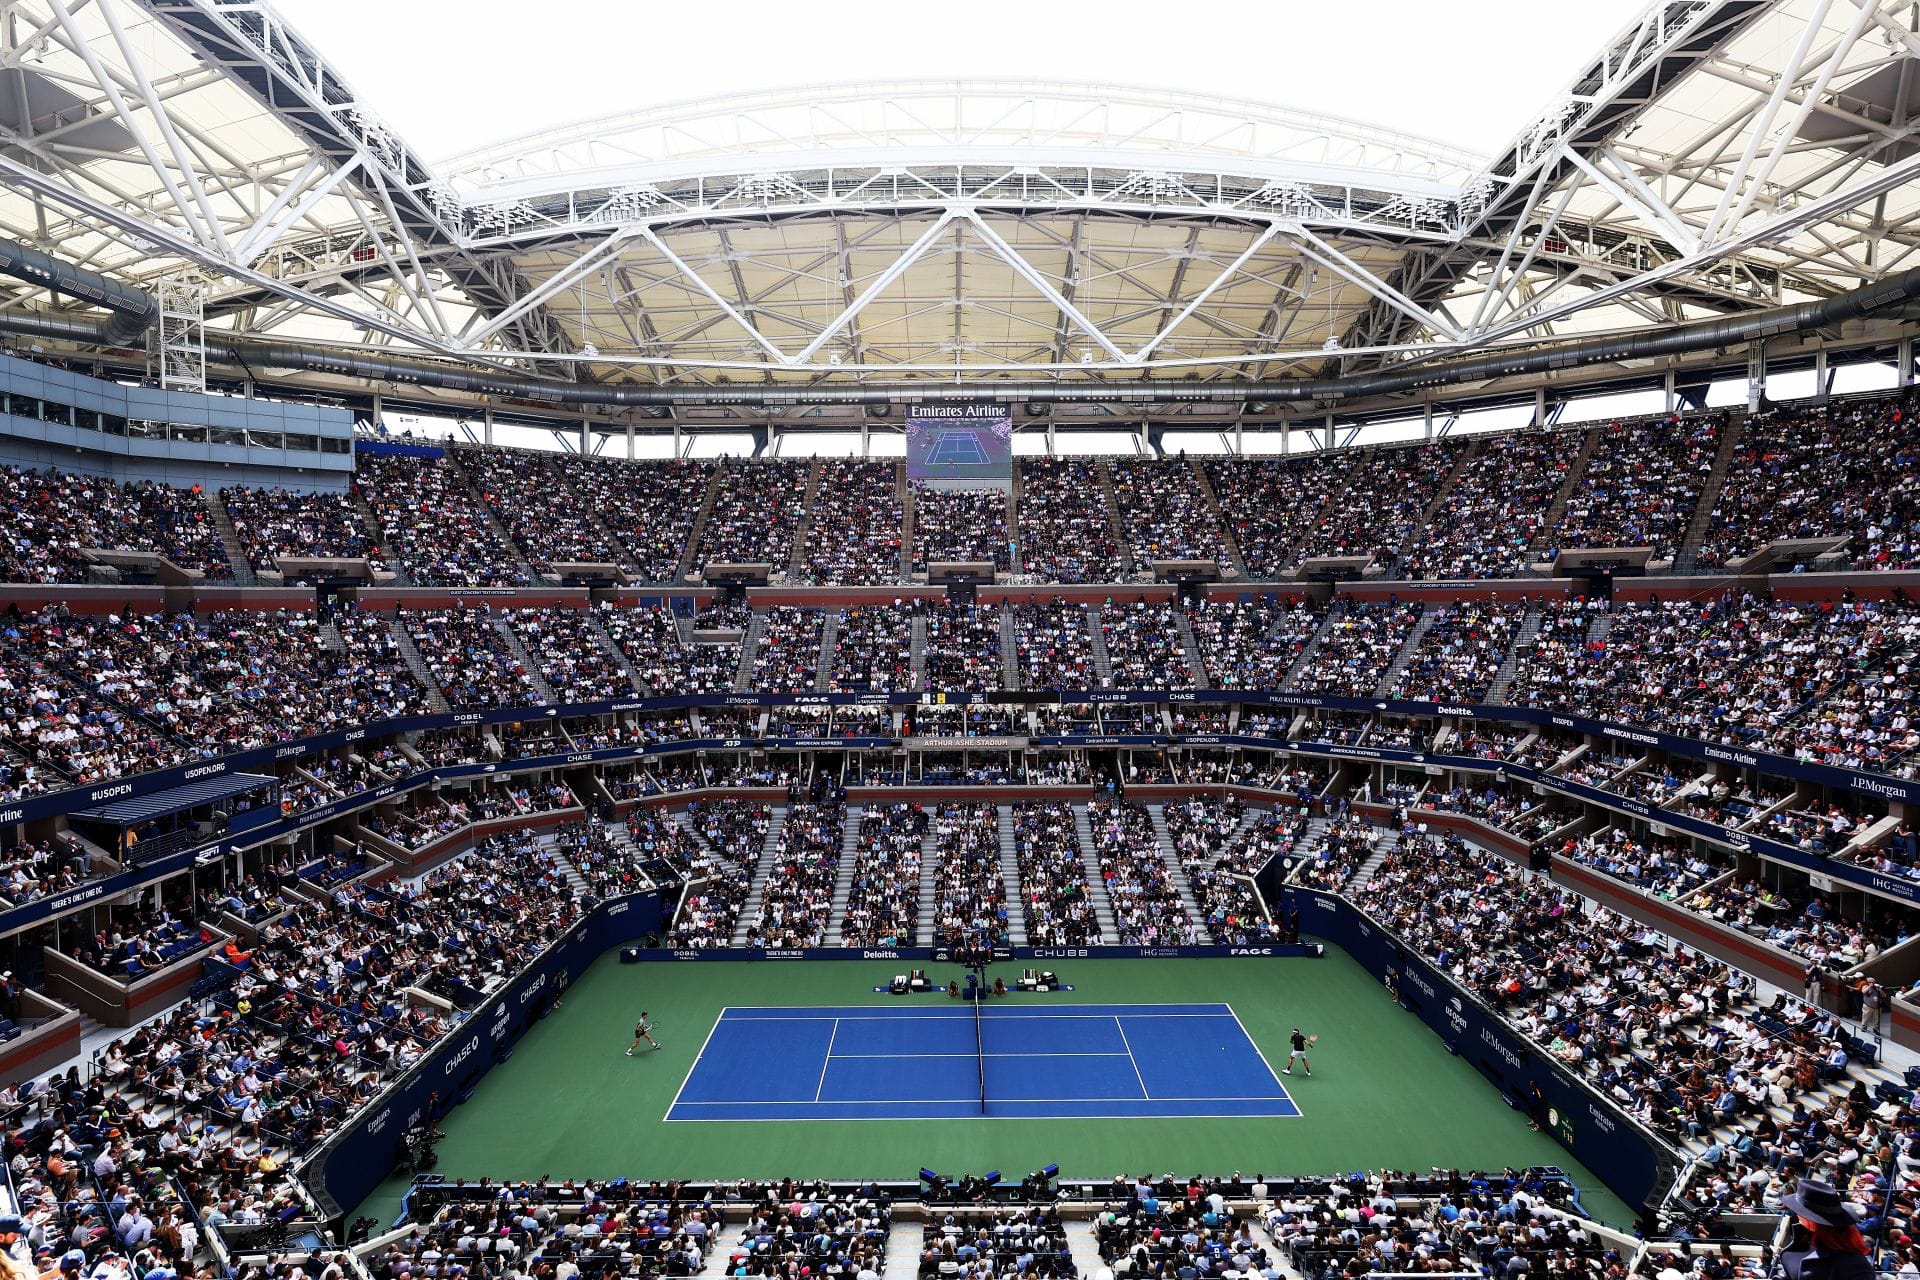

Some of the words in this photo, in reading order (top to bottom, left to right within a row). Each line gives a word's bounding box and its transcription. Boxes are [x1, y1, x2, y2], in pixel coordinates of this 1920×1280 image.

[911, 405, 963, 417] Emirates
[965, 405, 1006, 417] Airline
[454, 713, 484, 721] DOBEL
[1437, 706, 1475, 716] Deloitte.
[345, 730, 366, 741] CHASE
[1603, 727, 1631, 740] AMERICAN
[1631, 732, 1659, 745] EXPRESS
[567, 753, 593, 763] CHASE
[1330, 747, 1355, 755] AMERICAN
[1356, 749, 1380, 757] EXPRESS
[1704, 746, 1733, 761] Emirates
[1733, 751, 1757, 766] Airline
[184, 762, 226, 779] USOPEN.ORG
[1536, 774, 1566, 789] CADILLAC
[91, 784, 132, 800] #USOPEN
[1622, 801, 1649, 815] CHUBB
[1725, 830, 1750, 843] DOBEL
[198, 845, 220, 859] ESPN
[1872, 877, 1891, 890] IHG
[51, 895, 72, 910] THERE'S
[72, 892, 85, 903] ONLY
[85, 888, 96, 899] ONE
[863, 950, 900, 959] Deloitte.
[1034, 949, 1089, 957] CHUBB
[1140, 948, 1158, 956] IHG
[520, 978, 540, 1004] CHASE
[1452, 1010, 1467, 1029] open
[445, 1042, 471, 1075] CHASE
[367, 1108, 391, 1133] Emirates
[1589, 1103, 1615, 1131] Emirates
